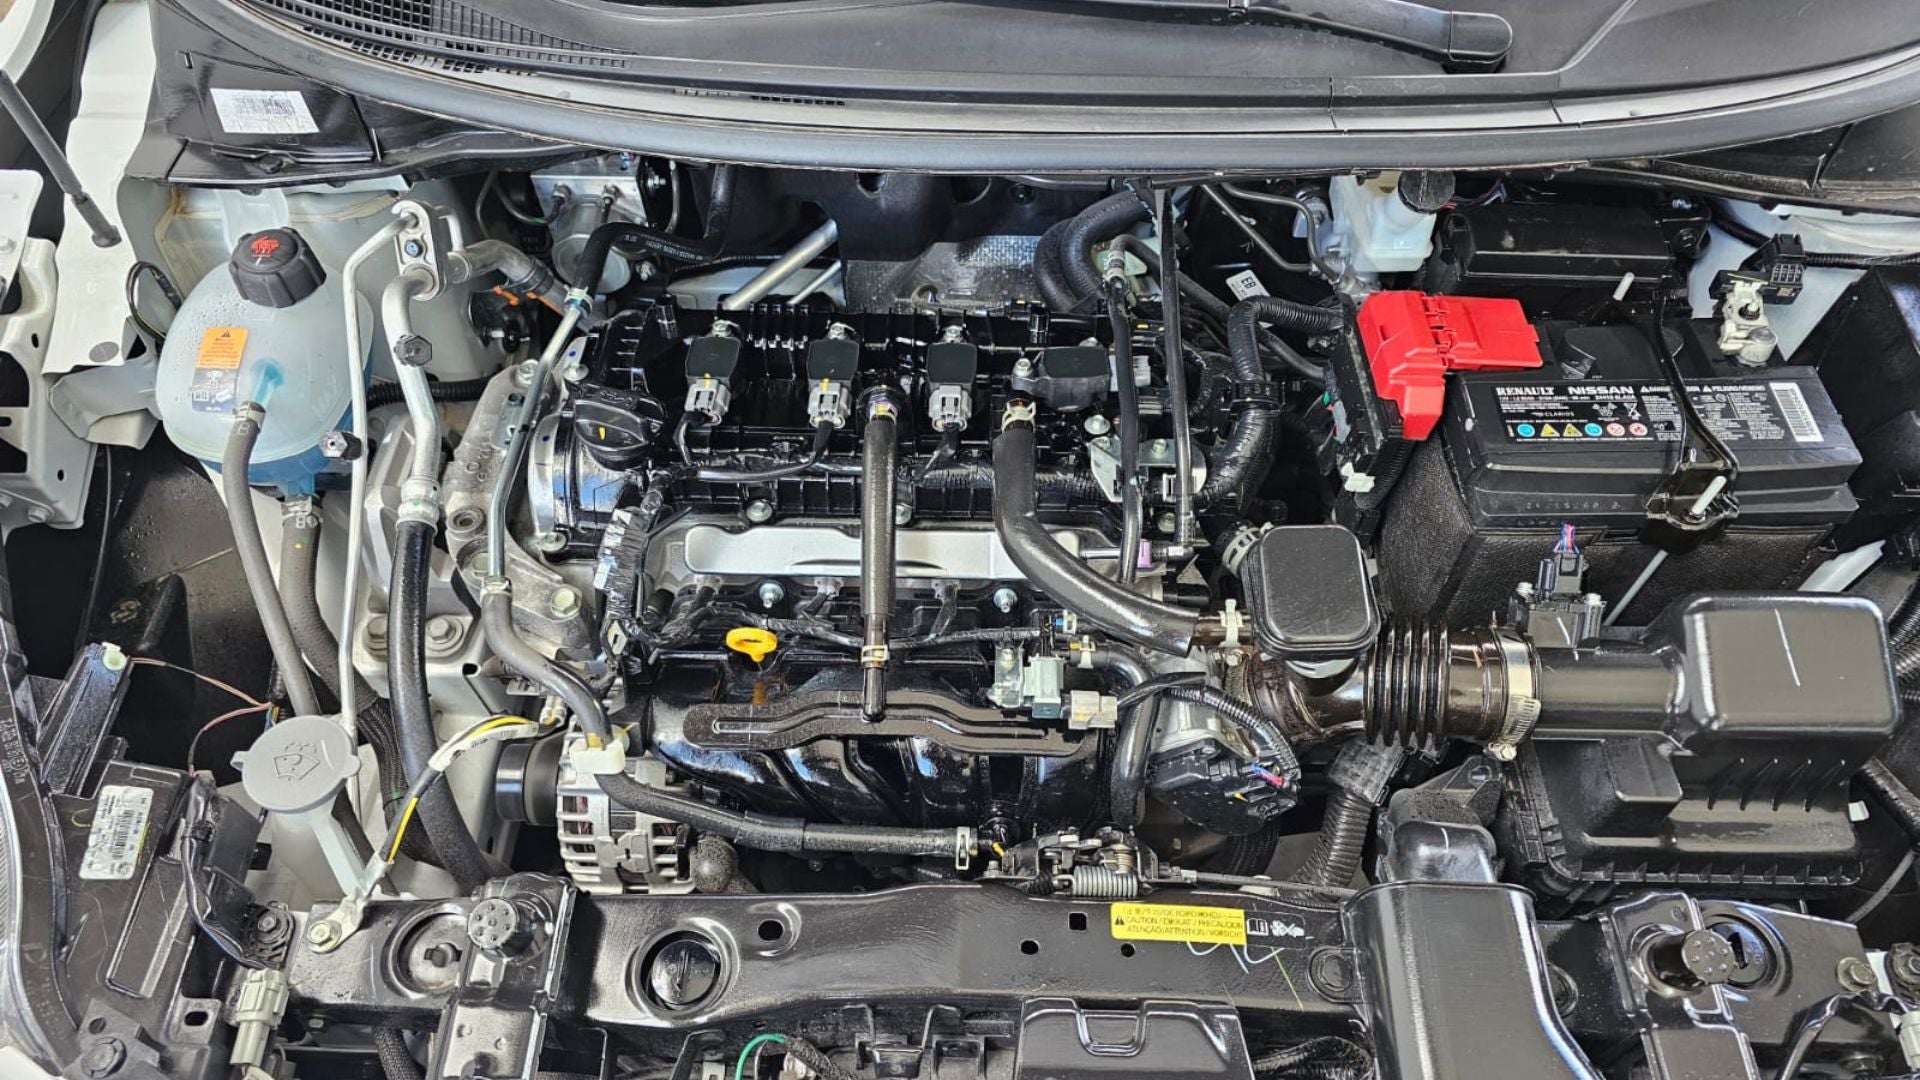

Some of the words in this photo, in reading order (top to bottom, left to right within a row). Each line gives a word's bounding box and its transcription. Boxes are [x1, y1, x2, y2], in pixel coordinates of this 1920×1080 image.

[1496, 386, 1554, 396] RENAULT
[1567, 386, 1634, 395] NISSAN
[1126, 917, 1157, 925] CAUTION
